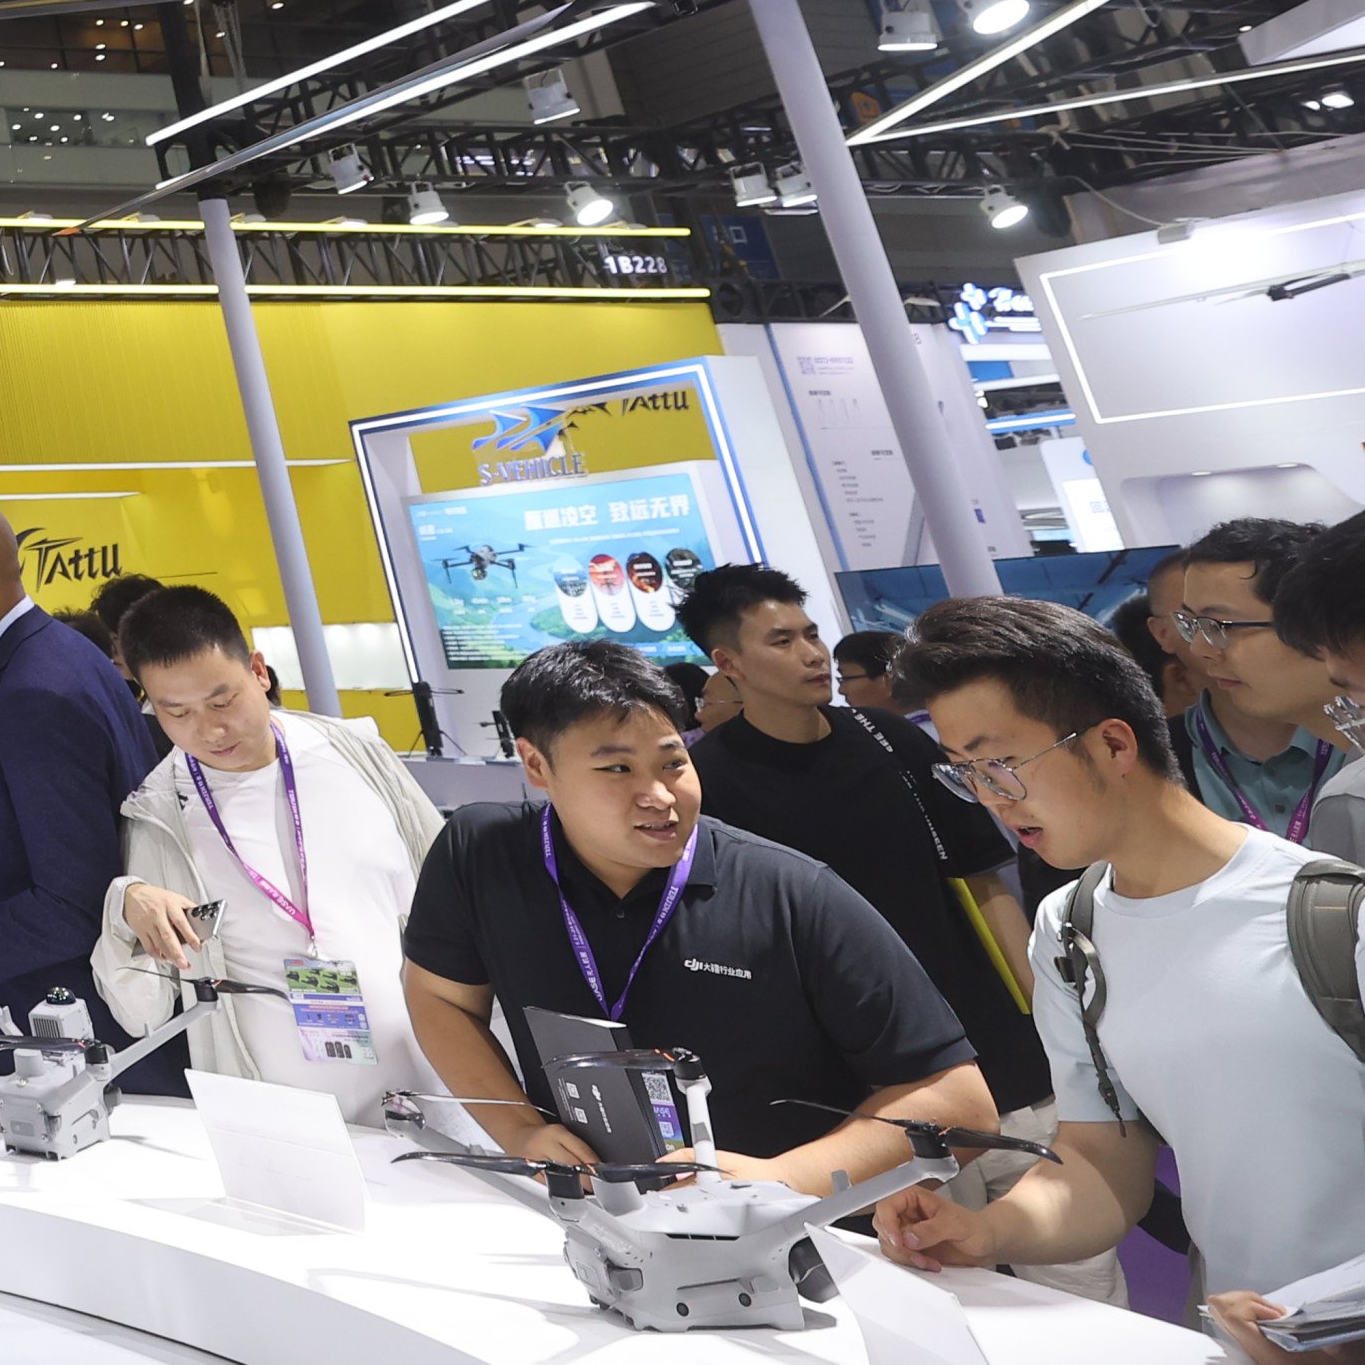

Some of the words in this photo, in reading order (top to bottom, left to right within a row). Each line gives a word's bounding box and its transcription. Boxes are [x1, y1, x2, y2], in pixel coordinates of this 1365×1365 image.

[604, 255, 667, 274] 1B228
[478, 453, 586, 486] S-VEHICLE
[609, 494, 691, 524] 致远无界
[855, 712, 875, 733] THE
